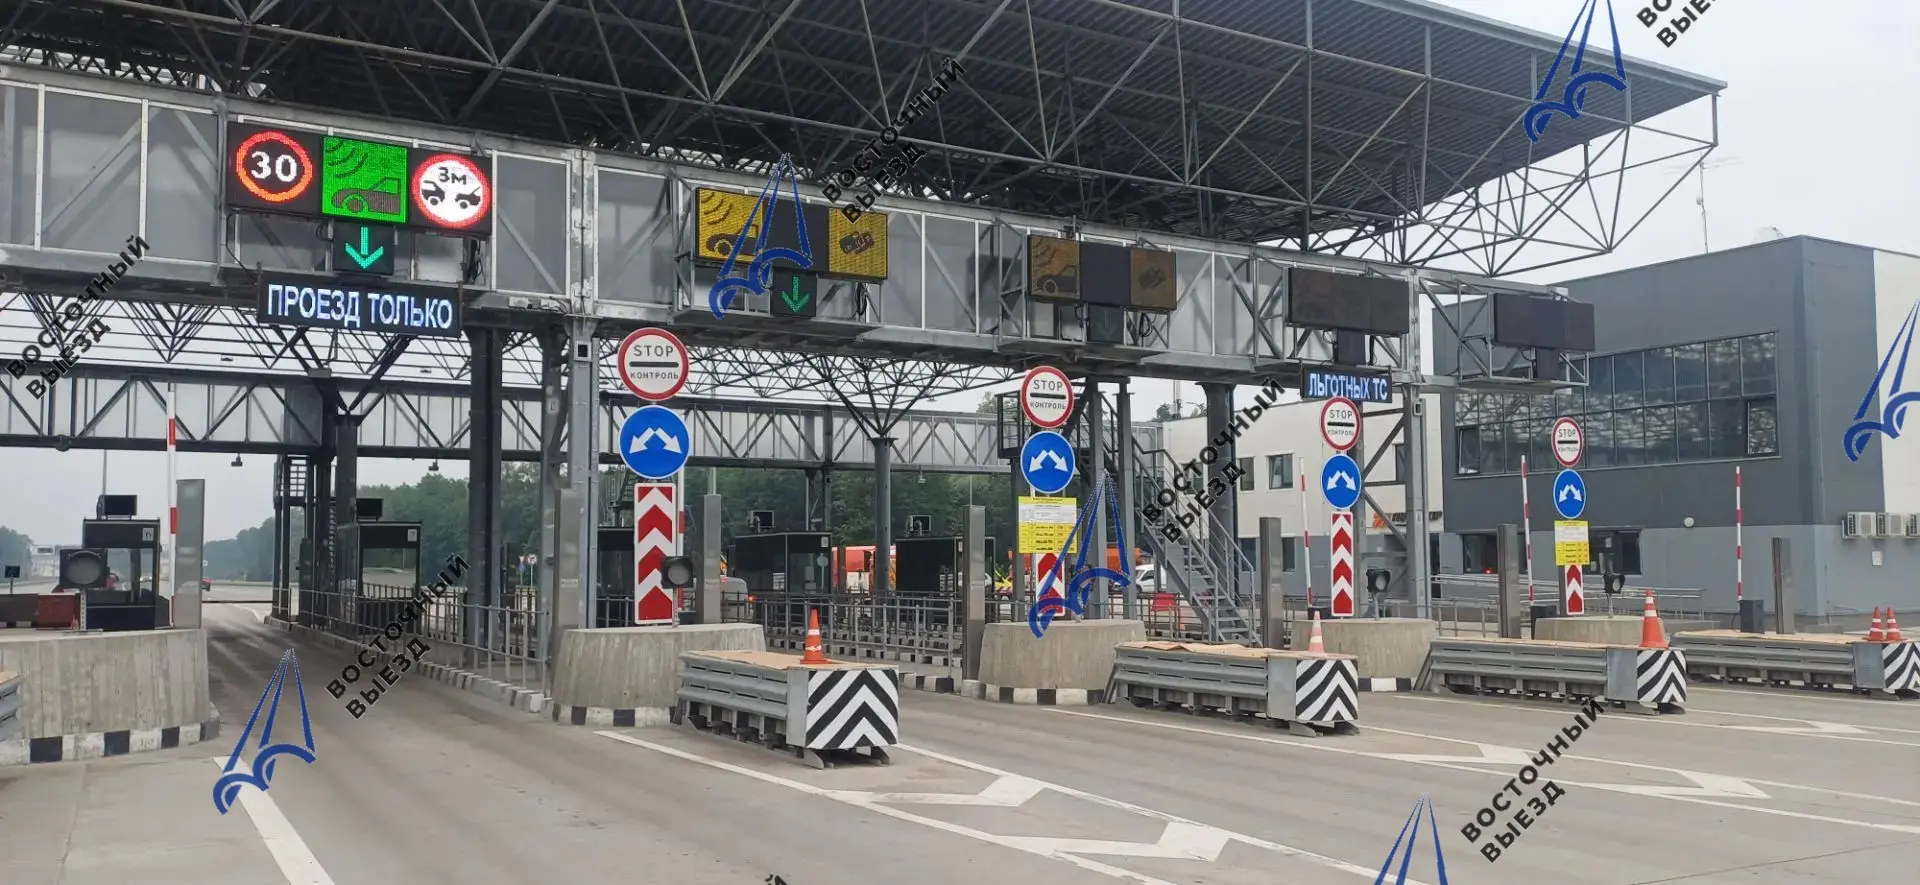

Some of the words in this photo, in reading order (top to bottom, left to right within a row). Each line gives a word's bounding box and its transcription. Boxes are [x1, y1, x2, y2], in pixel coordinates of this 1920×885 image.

[251, 151, 298, 182] 30
[268, 284, 360, 328] ПРОЕЗД
[367, 292, 453, 329] ТОЛЬКО
[633, 345, 674, 357] STOP
[630, 371, 679, 380] КОНТРОЛЬ
[1033, 379, 1063, 391] STOP
[1309, 373, 1370, 400] ЛЬГОТНЫХ
[1373, 377, 1388, 400] ТС
[1030, 401, 1066, 410] КОНТРОЛЬ
[1329, 410, 1353, 419] STOP
[1558, 429, 1576, 438] STOP
